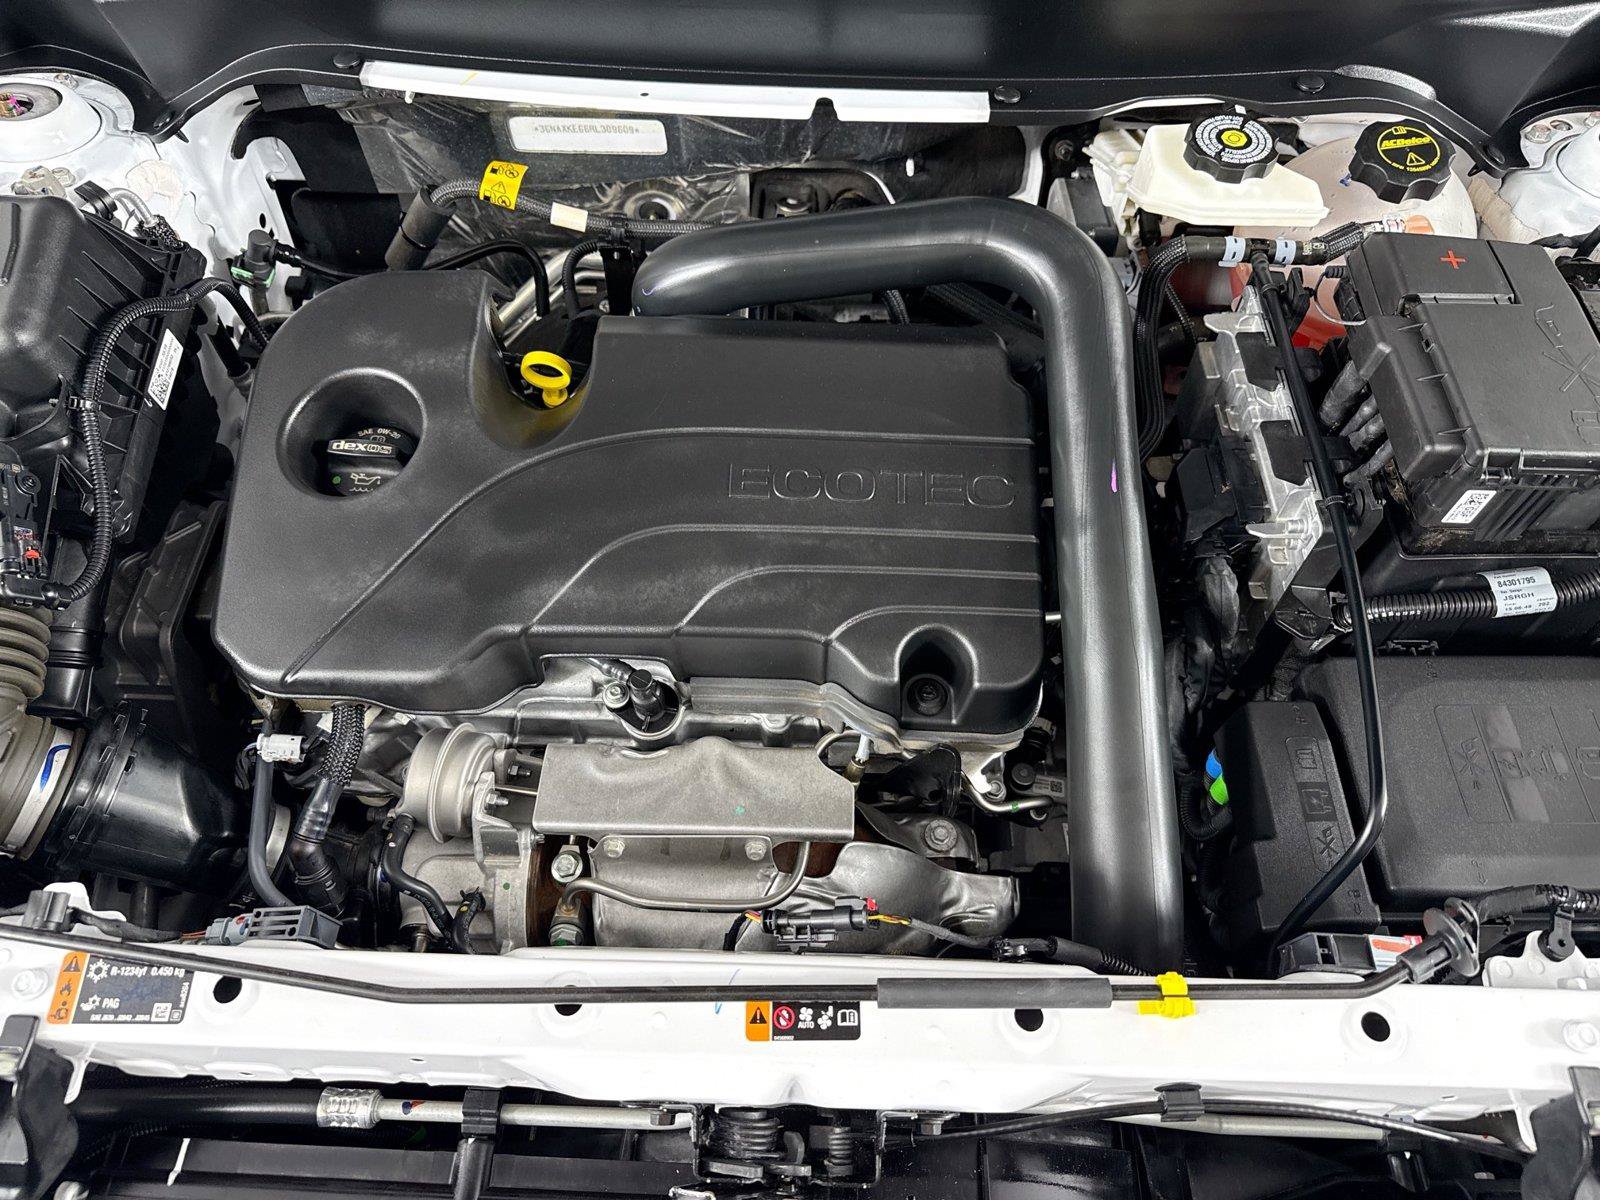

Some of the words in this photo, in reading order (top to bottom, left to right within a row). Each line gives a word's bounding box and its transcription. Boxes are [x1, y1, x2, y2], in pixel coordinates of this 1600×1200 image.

[1382, 137, 1430, 148] ACDelco
[358, 429, 373, 437] SAE
[377, 428, 401, 439] 0W-20
[332, 441, 393, 454] dexos
[729, 464, 1015, 509] ECOTEC
[1497, 576, 1536, 588] 84301795
[151, 966, 173, 977] 0.450
[102, 998, 120, 1009] PAG
[798, 1021, 814, 1029] AUTO
